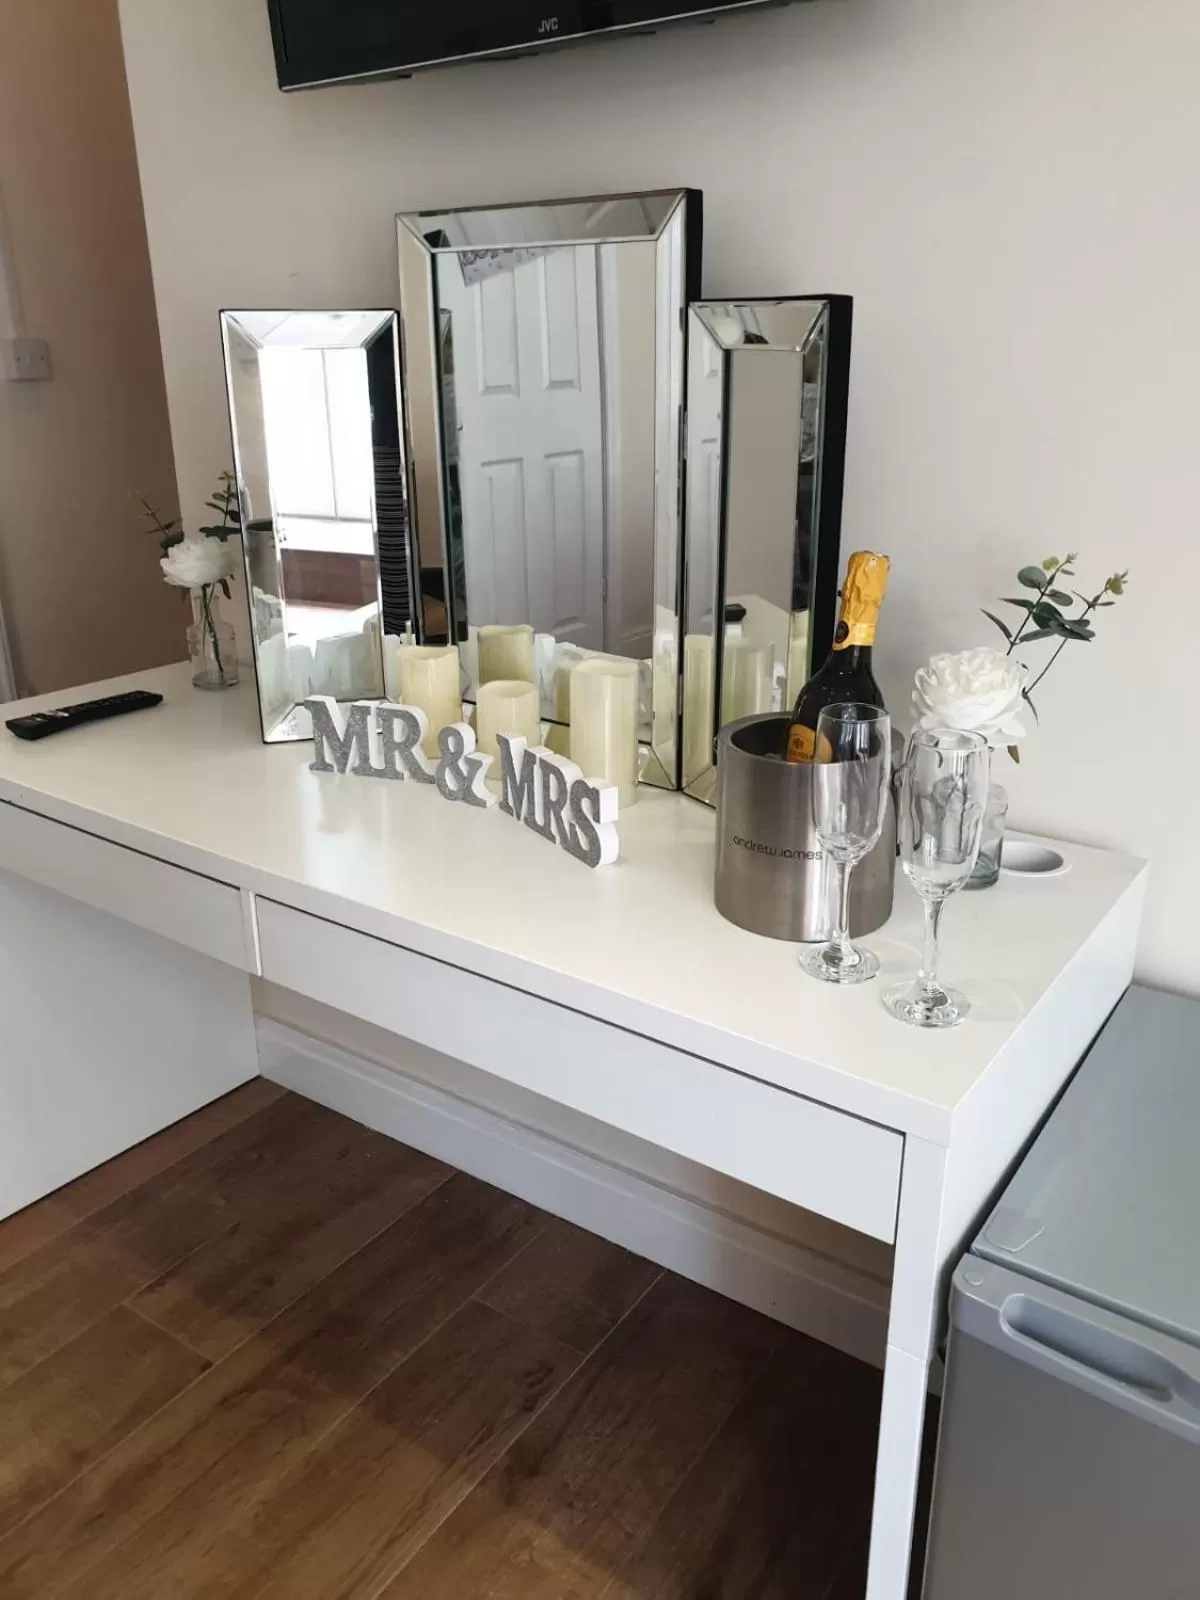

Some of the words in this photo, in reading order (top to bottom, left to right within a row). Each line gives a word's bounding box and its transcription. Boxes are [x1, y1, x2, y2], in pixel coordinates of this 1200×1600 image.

[538, 17, 559, 33] JVC
[304, 697, 436, 784] MR
[435, 725, 489, 808] &
[496, 733, 603, 869] MRS
